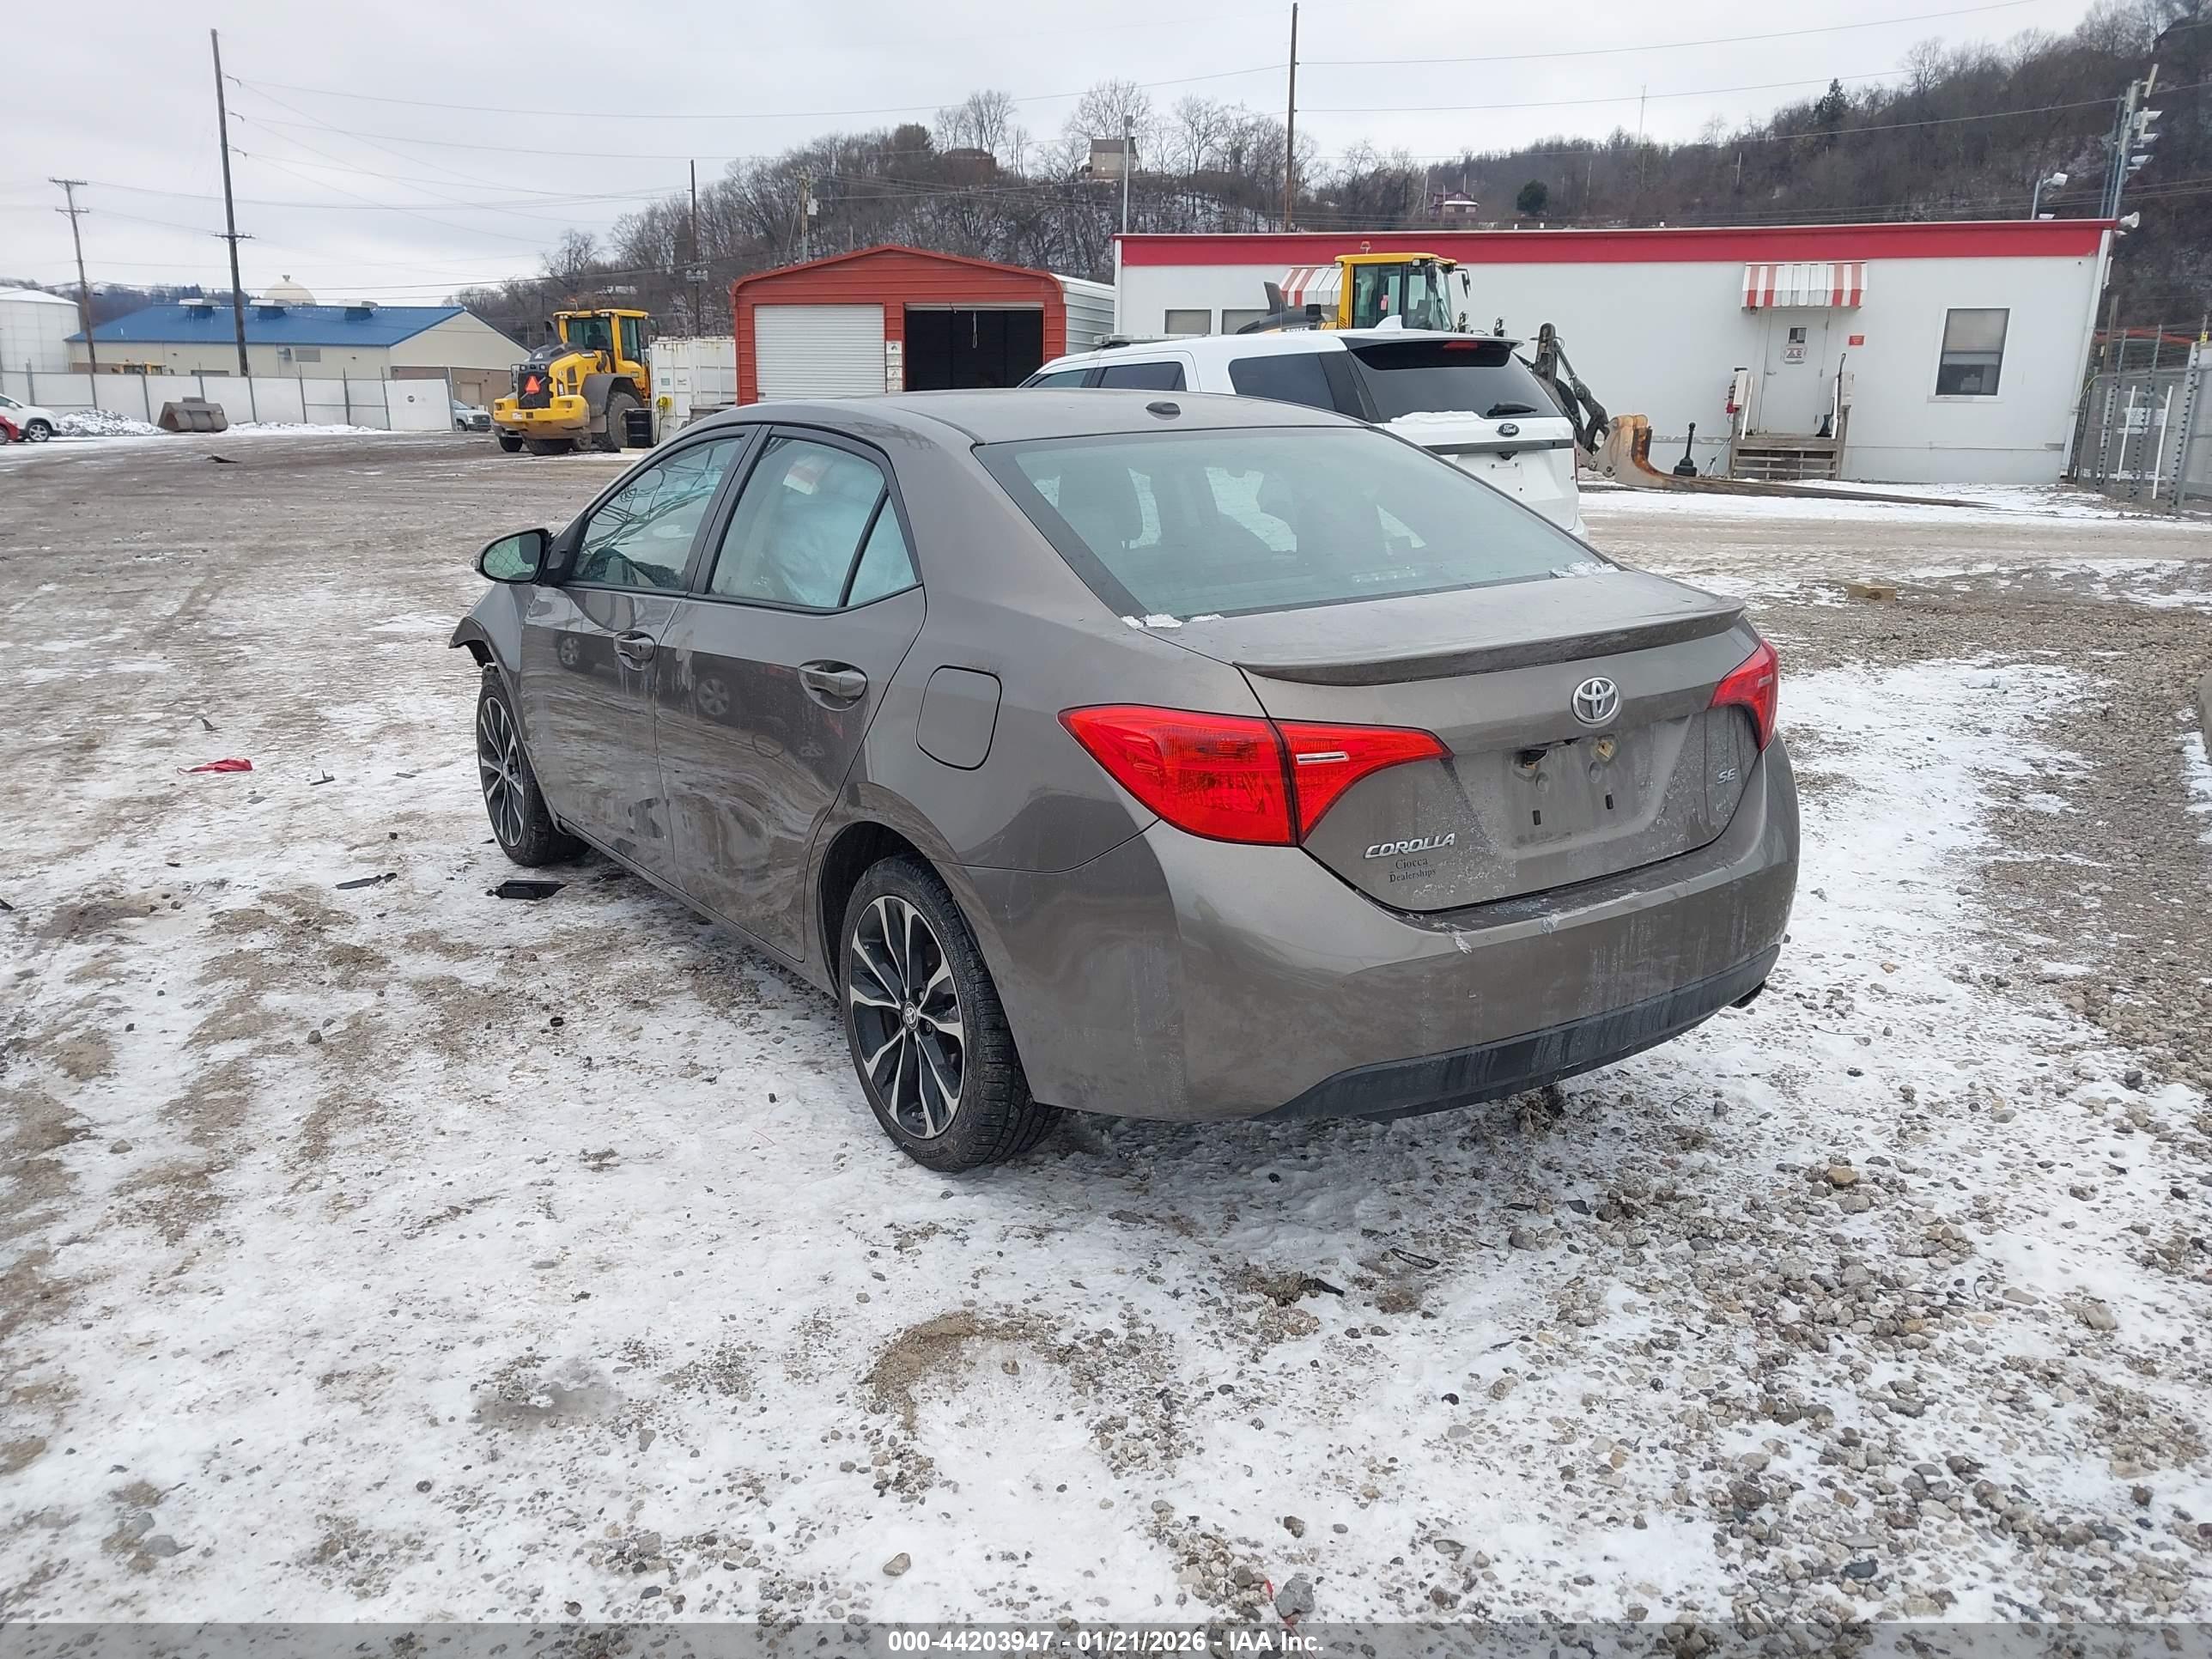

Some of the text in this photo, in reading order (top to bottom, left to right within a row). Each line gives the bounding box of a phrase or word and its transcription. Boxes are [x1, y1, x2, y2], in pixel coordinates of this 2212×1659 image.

[1717, 768, 1736, 784] SE
[1364, 832, 1455, 859] COROLLA
[1395, 858, 1429, 870] Ciocca
[1389, 866, 1437, 884] Dealerships
